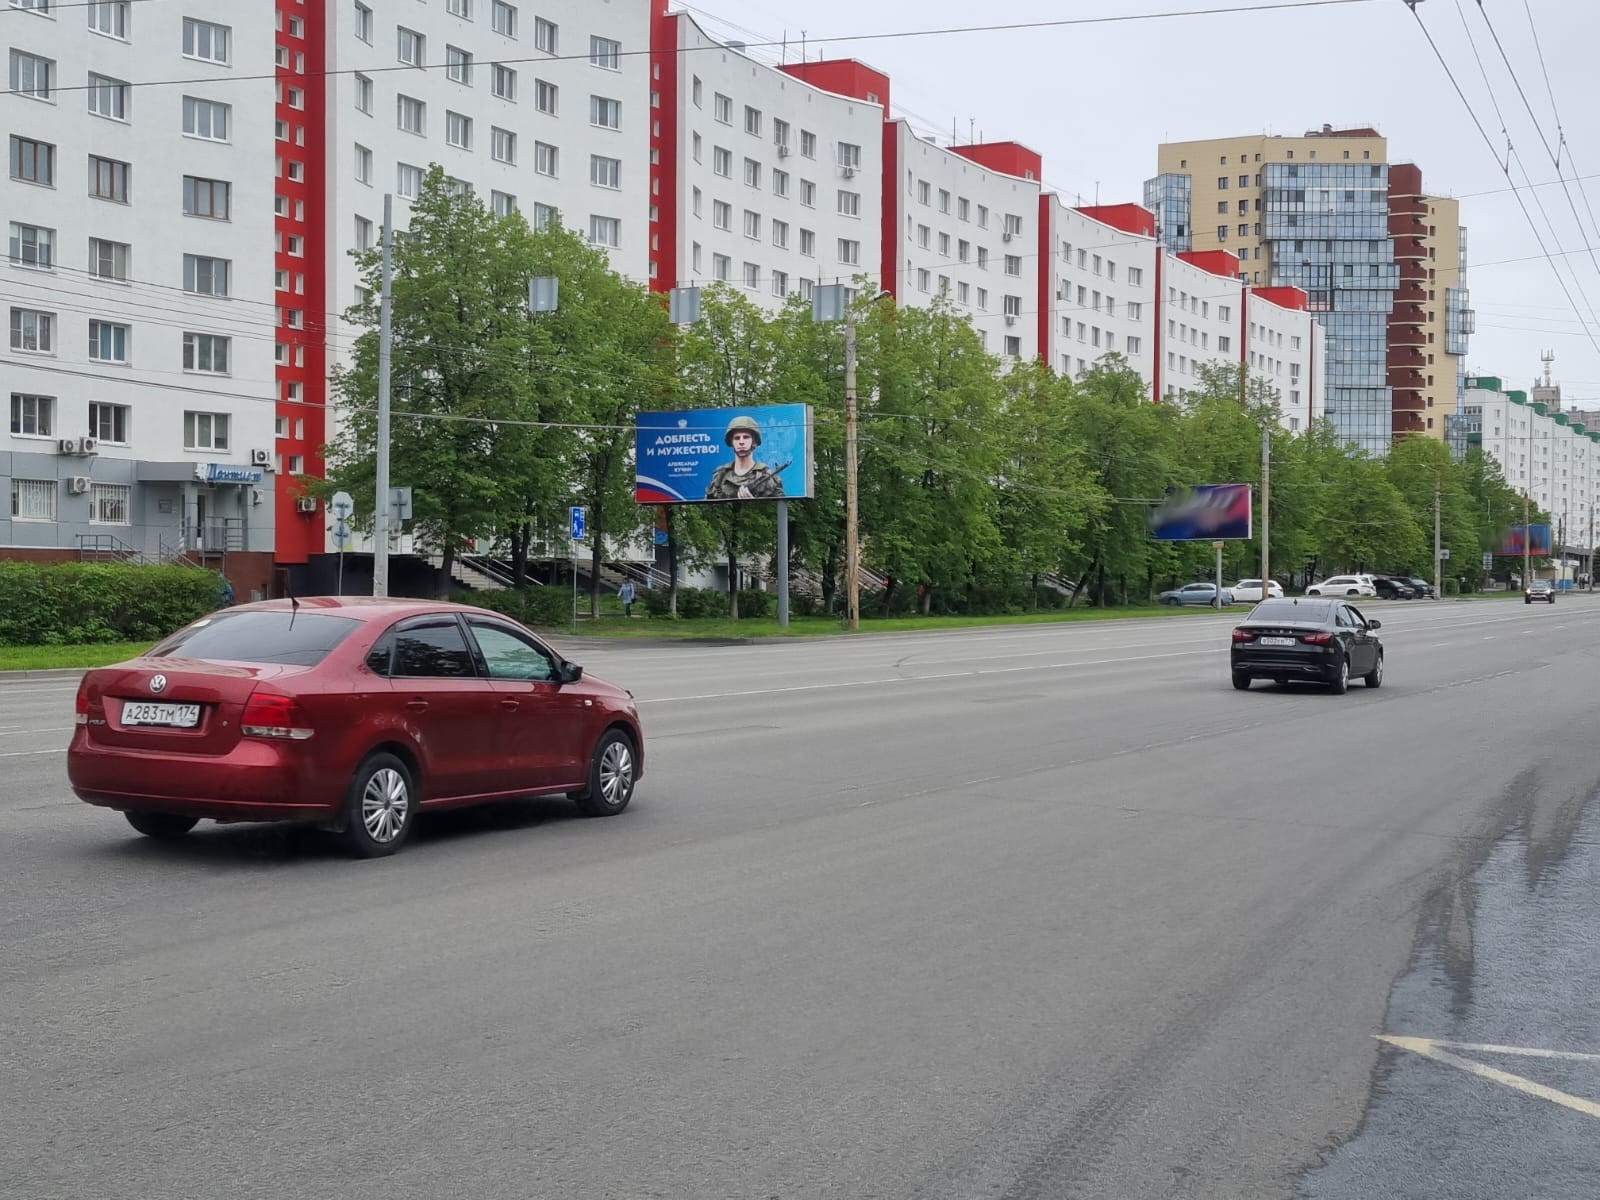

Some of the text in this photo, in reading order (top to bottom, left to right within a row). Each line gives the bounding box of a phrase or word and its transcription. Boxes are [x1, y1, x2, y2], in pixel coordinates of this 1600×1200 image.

[655, 433, 711, 445] ДОБЛЕСТЬ
[646, 445, 720, 457] И МУЖЕСТВО!
